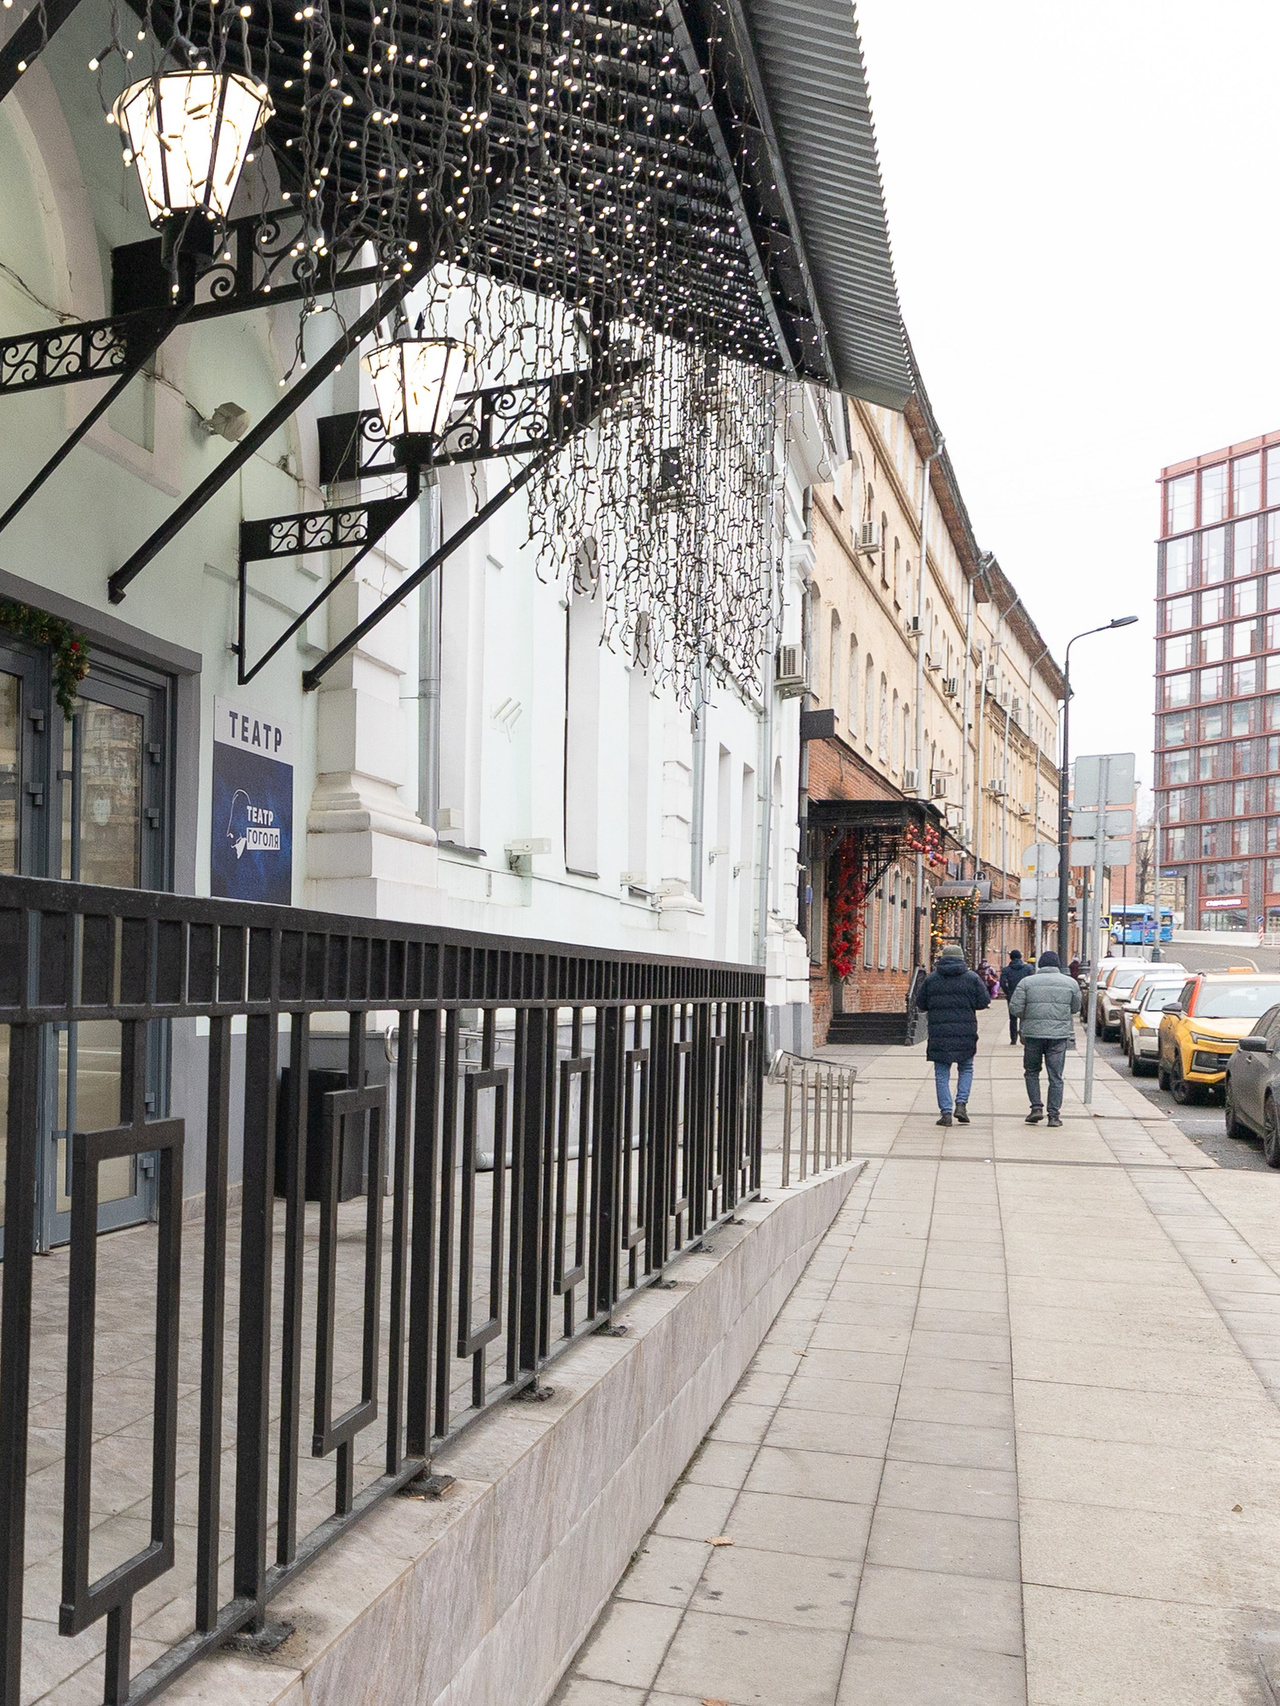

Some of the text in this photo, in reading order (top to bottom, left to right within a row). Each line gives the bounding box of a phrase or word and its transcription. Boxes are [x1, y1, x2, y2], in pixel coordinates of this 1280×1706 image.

[229, 710, 282, 752] ТЕАТР
[247, 805, 274, 826] ТЕАТР
[247, 829, 279, 849] ГОГОЛЯ
